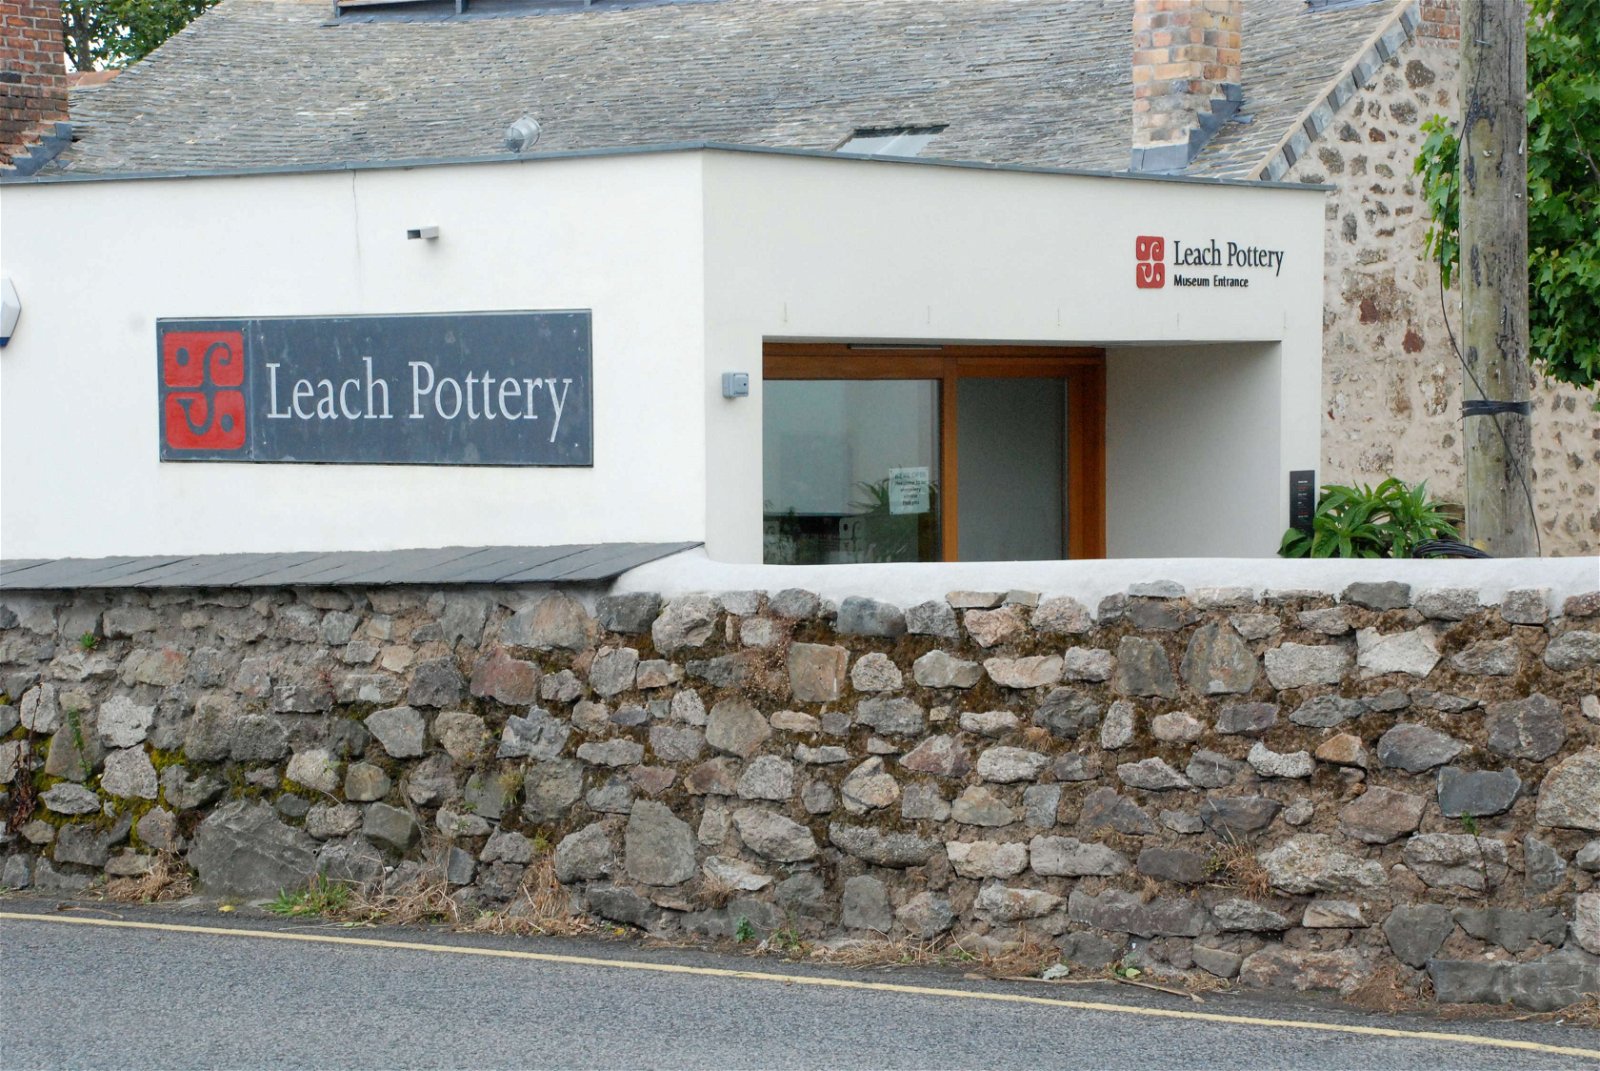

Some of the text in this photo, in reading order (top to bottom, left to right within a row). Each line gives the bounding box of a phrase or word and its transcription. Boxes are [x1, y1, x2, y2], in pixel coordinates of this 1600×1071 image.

[1174, 239, 1284, 277] Leach Pottery
[1174, 273, 1249, 288] Museum Entrance
[266, 356, 573, 443] Leach Pottery
